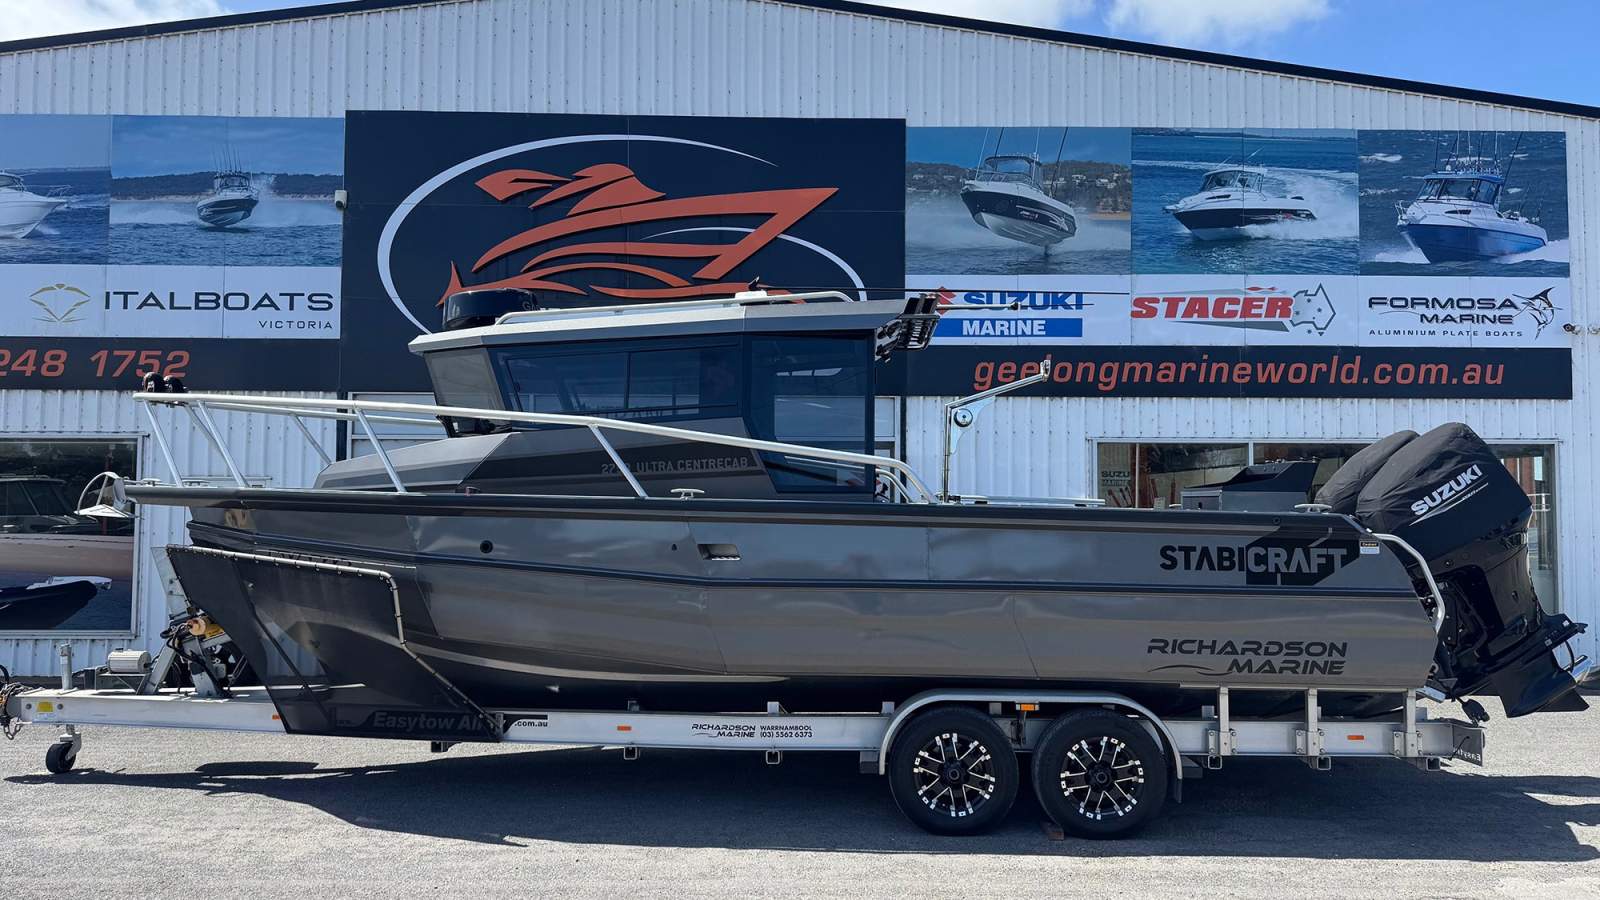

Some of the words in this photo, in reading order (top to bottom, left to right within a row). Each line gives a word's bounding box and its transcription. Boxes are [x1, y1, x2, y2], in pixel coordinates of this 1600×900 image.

[104, 291, 334, 311] ITALBOATS
[963, 291, 1084, 311] SUZUKI
[1130, 296, 1294, 319] STACER
[1368, 296, 1519, 310] FORMOSA
[258, 320, 333, 330] VICTORIA
[962, 320, 1046, 336] MARINE
[1419, 313, 1514, 324] MARINE
[90, 349, 191, 378] 1752
[636, 460, 675, 474] ULTRA
[677, 456, 749, 472] CENTRECAB
[1410, 463, 1484, 516] SUZUKI
[1159, 544, 1348, 573] STABICRAFT
[1147, 638, 1348, 658] RICHARDSON
[1227, 658, 1347, 675] MARINE
[373, 711, 450, 731] Easytow
[514, 719, 549, 728] .com.au
[691, 723, 757, 732] RICHARDSON
